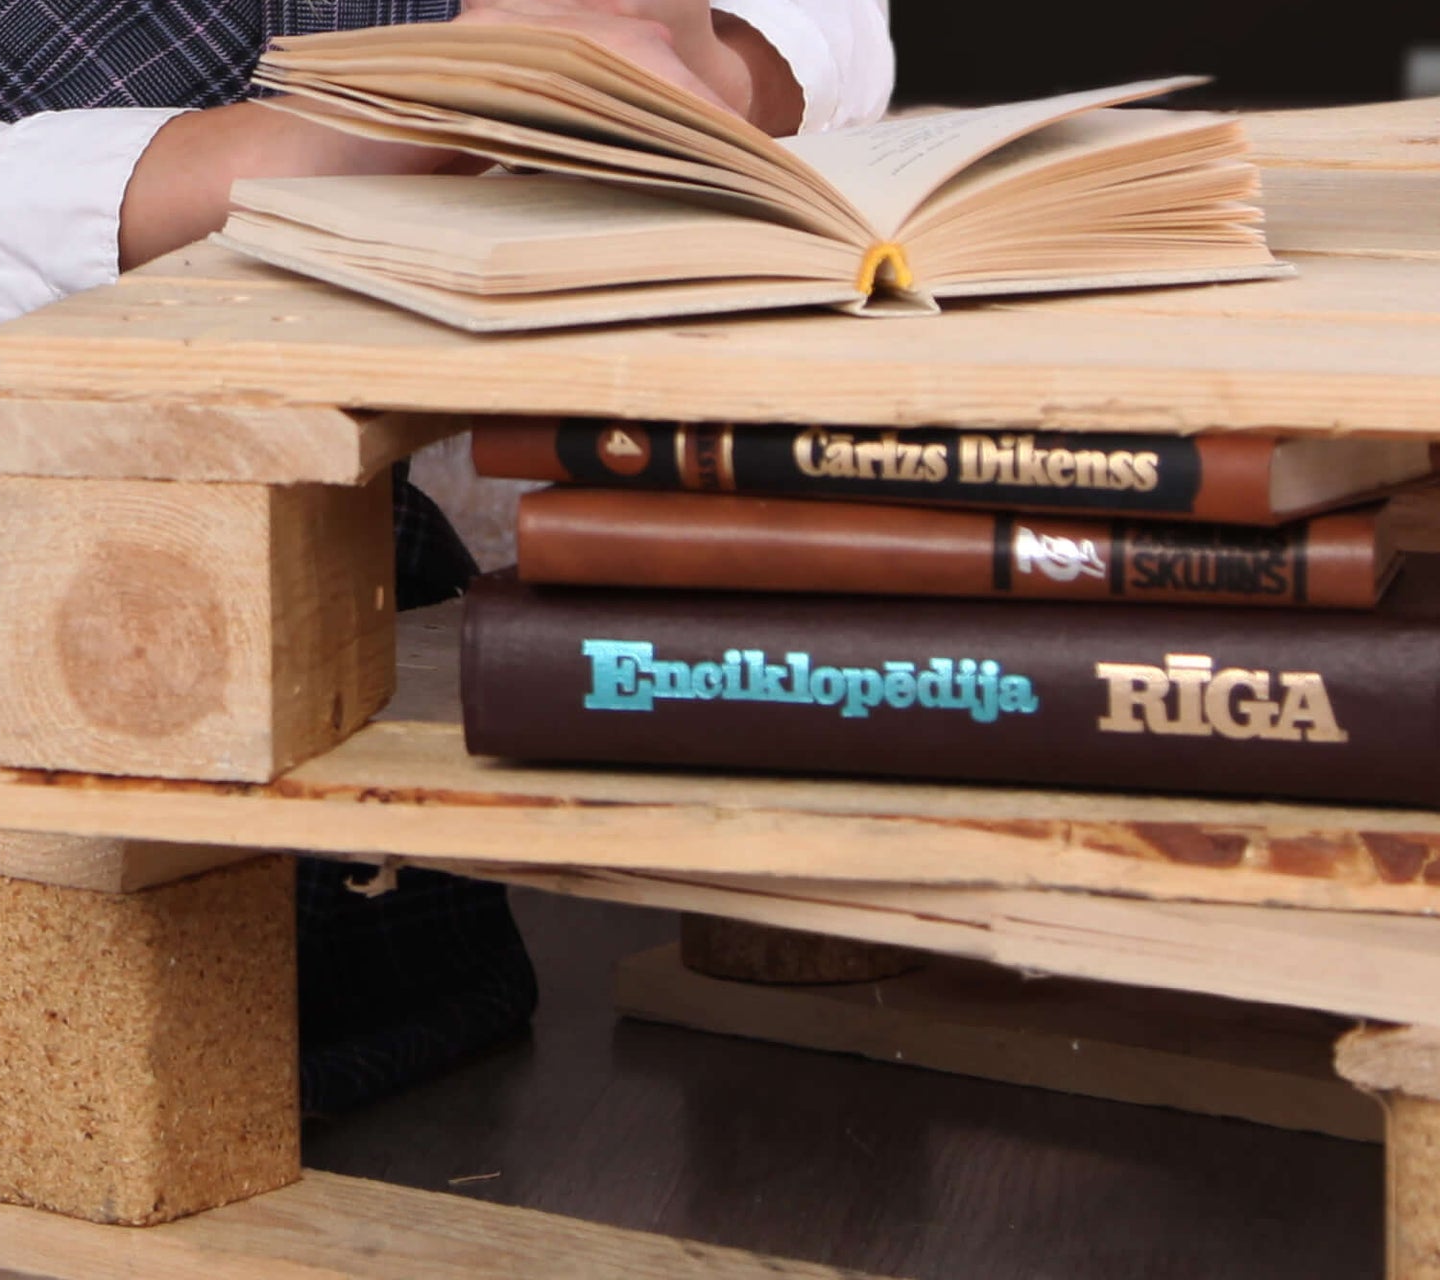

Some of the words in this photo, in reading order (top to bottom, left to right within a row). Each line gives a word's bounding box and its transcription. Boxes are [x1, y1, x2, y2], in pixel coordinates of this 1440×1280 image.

[958, 433, 1160, 492] Dikenss
[581, 639, 1040, 723] Enciklopēdija
[1093, 651, 1348, 743] RĪGA
